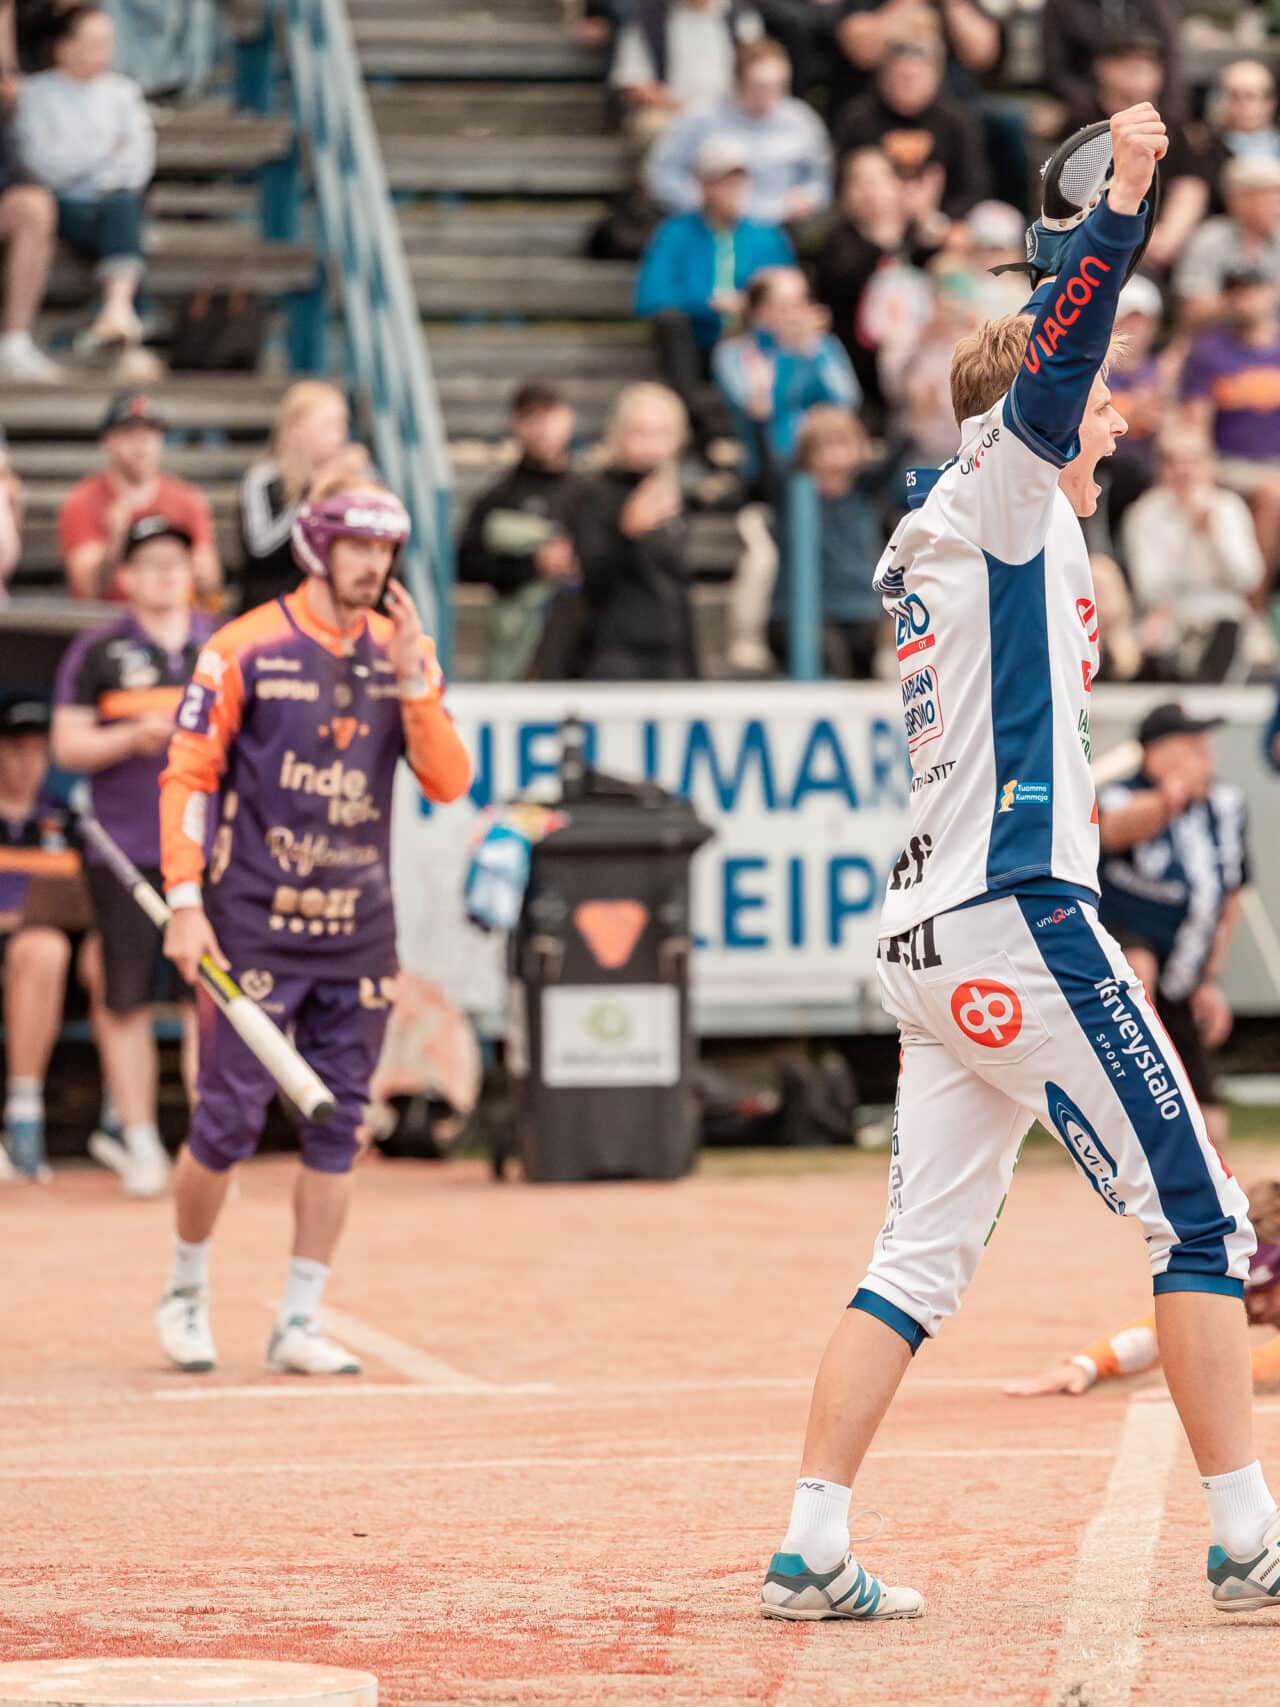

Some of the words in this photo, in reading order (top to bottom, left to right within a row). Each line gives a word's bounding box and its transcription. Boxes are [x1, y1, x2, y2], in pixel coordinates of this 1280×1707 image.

[1024, 255, 1111, 375] VIACON
[906, 470, 918, 488] 25
[1096, 1033, 1127, 1079] SPORT
